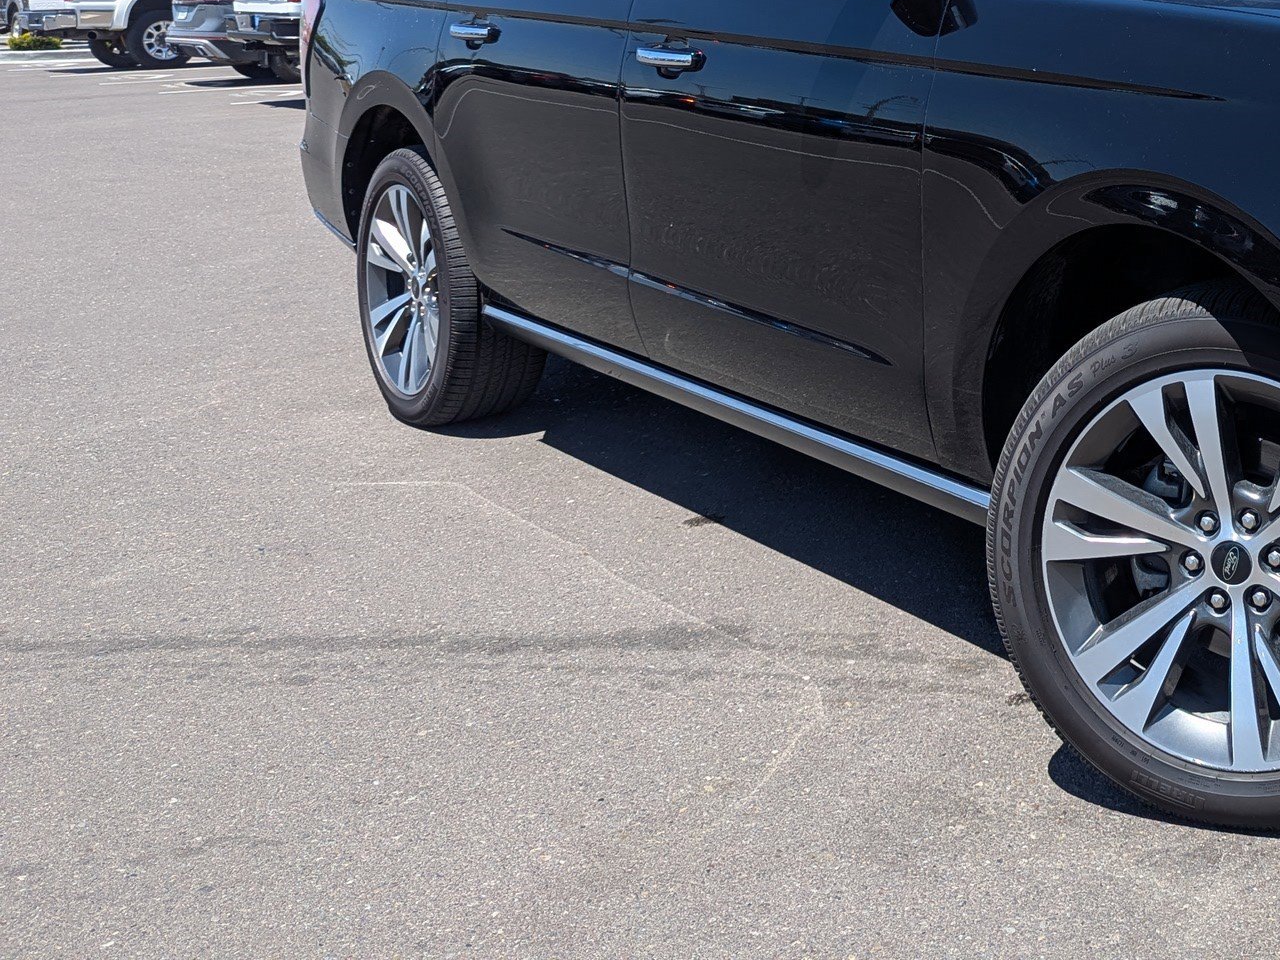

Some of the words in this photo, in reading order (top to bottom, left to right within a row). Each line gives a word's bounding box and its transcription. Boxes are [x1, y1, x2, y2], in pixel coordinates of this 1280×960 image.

[1000, 419, 1044, 608] SCORPION
[1051, 371, 1084, 420] AS
[1090, 353, 1117, 379] Plus
